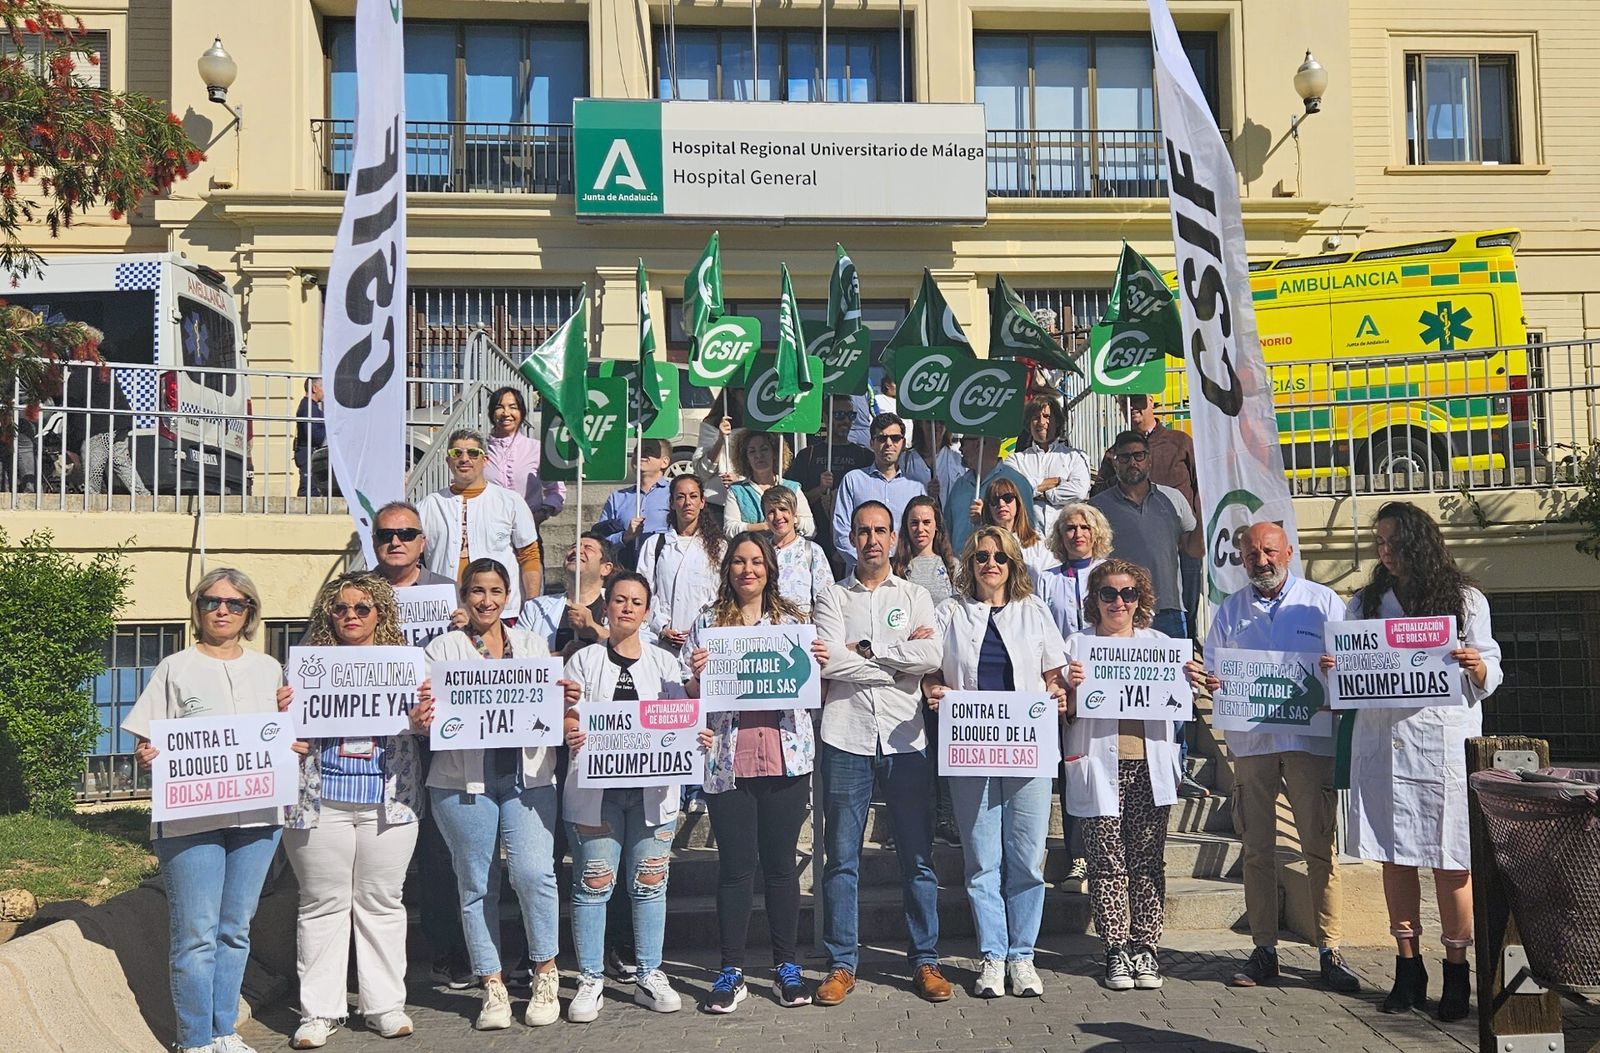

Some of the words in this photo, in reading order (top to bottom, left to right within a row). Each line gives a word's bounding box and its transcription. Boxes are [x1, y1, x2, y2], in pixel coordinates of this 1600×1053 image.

[672, 140, 736, 158] Hospital
[740, 141, 805, 158] Regional
[811, 141, 907, 157] Universitario
[910, 142, 928, 157] de
[932, 141, 984, 161] Málaga
[672, 168, 745, 187] Hospital
[751, 170, 817, 186] General
[582, 193, 605, 201] Junta
[607, 193, 617, 201] de
[618, 192, 658, 201] Andalucía
[1166, 139, 1241, 417] CSIF
[1280, 271, 1398, 294] AMBULANCIA
[704, 341, 753, 360] CSIF
[1260, 337, 1292, 347] NORIO
[1108, 348, 1157, 367] CSIF
[1273, 379, 1305, 392] CIAS
[963, 385, 1017, 408] CSIF
[396, 600, 452, 623] TALINA
[1391, 621, 1444, 634] ¡ACTUALIZACIÓN
[734, 637, 773, 653] CONTRA
[775, 637, 788, 652] LA
[1396, 635, 1406, 643] DE
[1406, 633, 1427, 642] BOLSA
[1428, 632, 1440, 641] YA!
[1090, 646, 1165, 663] ACTUALIZACIÓN
[1169, 649, 1181, 663] DE
[1336, 652, 1400, 671] PROMESAS
[332, 662, 416, 687] CATALINA
[707, 657, 780, 675] INSOPORTABLE
[1094, 665, 1131, 680] CORTES
[1134, 666, 1175, 681] 2022-23
[1247, 662, 1287, 678] CONTRA
[445, 666, 531, 686] ACTUALIZACIÓN
[536, 668, 549, 683] DE
[1338, 671, 1449, 696] INCUMPLIDAS
[451, 689, 492, 705] CORTES
[496, 688, 543, 704] 2022-23
[707, 680, 754, 696] LENTITUD
[756, 679, 775, 694] DEL
[777, 678, 797, 693] SAS
[1220, 680, 1293, 699] INSOPORTABLE
[1120, 685, 1149, 712] ¡YA!
[303, 693, 380, 725] ¡CUMPLE
[645, 702, 694, 715] ¡ACTUALIZACIÓN
[952, 703, 994, 719] CONTRA
[998, 704, 1010, 719] EL
[1220, 700, 1265, 718] LENTITUD
[1268, 704, 1287, 719] DEL
[1289, 706, 1308, 720] SAS
[445, 723, 464, 732] CSIF
[480, 709, 514, 739] ¡YA!
[649, 716, 657, 725] DE
[659, 715, 677, 724] BOLSA
[679, 714, 690, 724] YA!
[167, 730, 220, 751] CONTRA
[223, 728, 239, 746] EL
[264, 727, 281, 735] CSIF
[952, 725, 999, 742] BLOQUEO
[1006, 726, 1020, 742] DE
[1023, 726, 1037, 742] LA
[587, 733, 651, 751] PROMESAS
[169, 755, 228, 778] BLOQUEO
[236, 752, 253, 771] DE
[256, 750, 273, 769] LA
[588, 751, 693, 775] INCUMPLIDAS
[951, 748, 986, 764] BOLSA
[989, 748, 1009, 764] DEL
[1012, 748, 1034, 765] SAS
[169, 782, 212, 804] BOLSA
[217, 779, 241, 799] DEL
[244, 776, 270, 797] SAS
